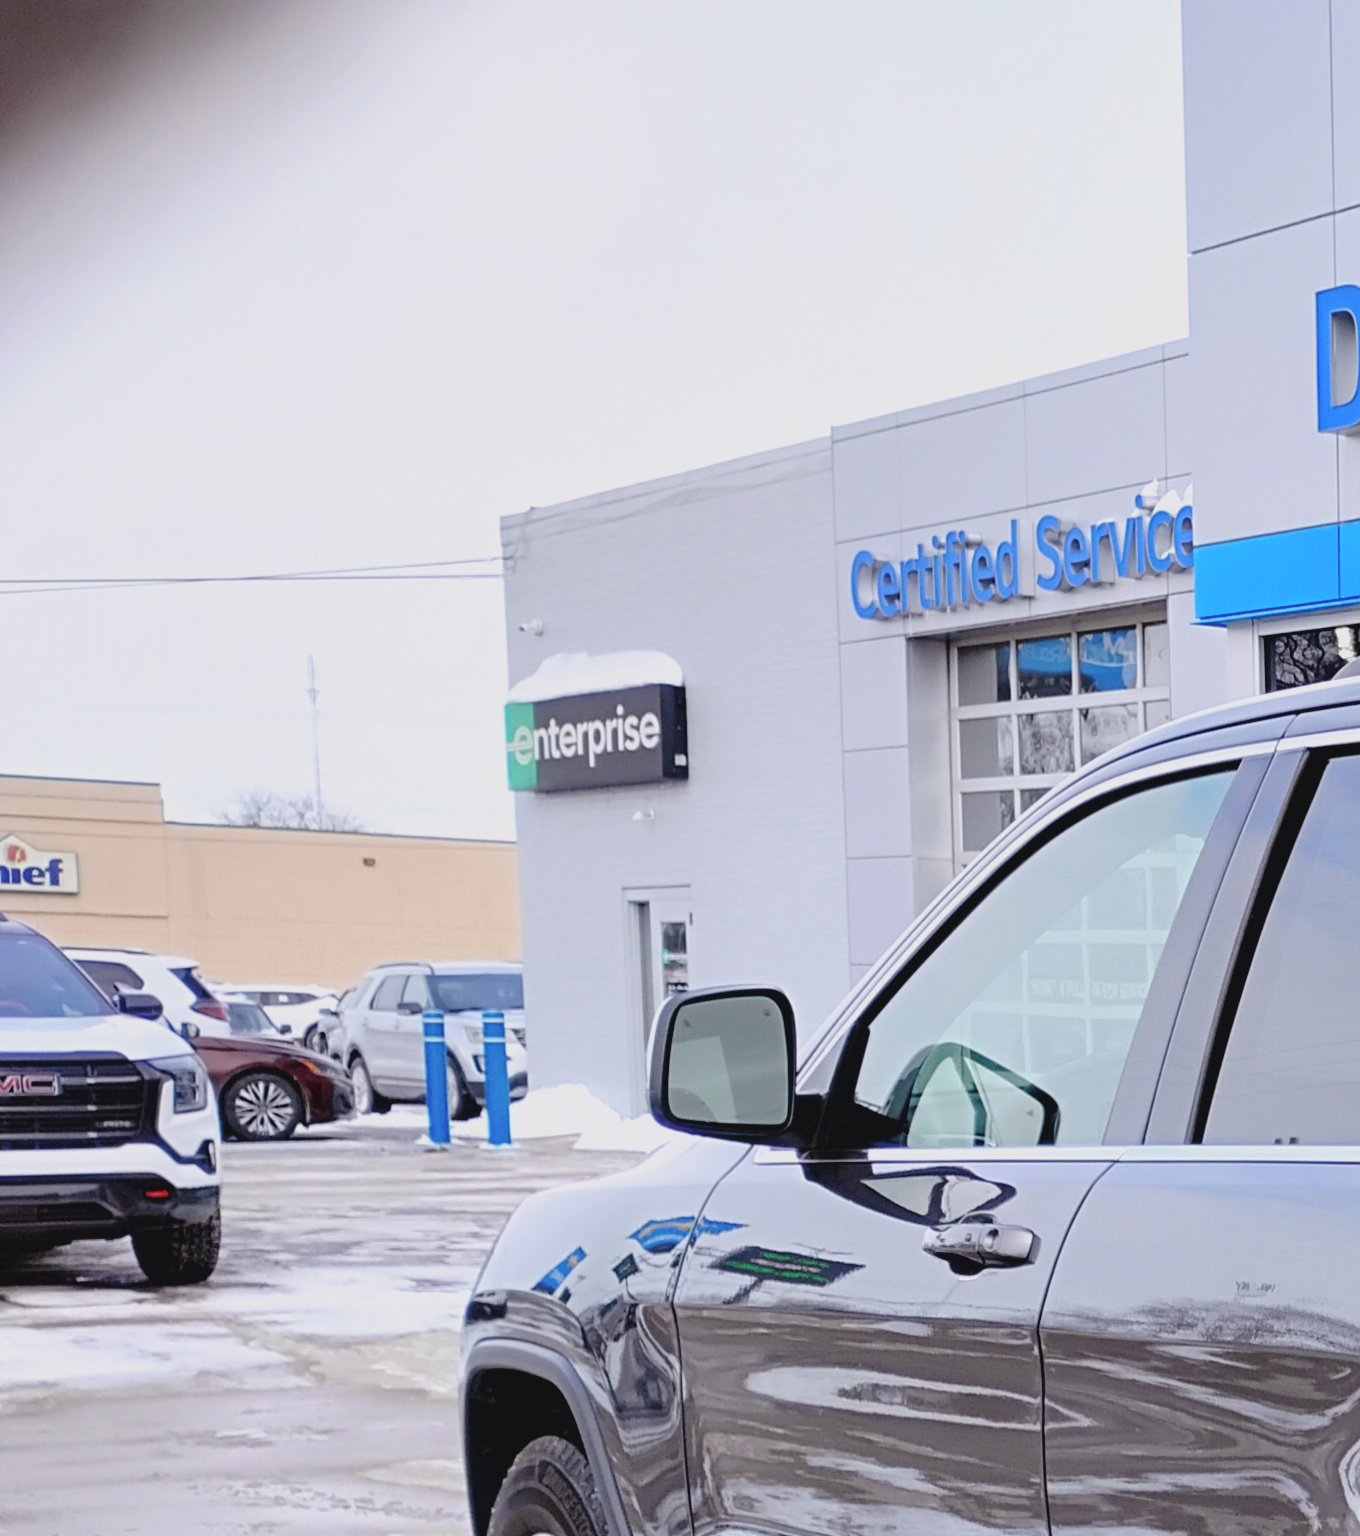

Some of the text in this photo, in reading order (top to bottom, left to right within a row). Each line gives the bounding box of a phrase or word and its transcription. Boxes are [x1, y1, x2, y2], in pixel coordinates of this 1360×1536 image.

[851, 494, 1194, 621] Certified Service
[508, 703, 661, 768] enterprise
